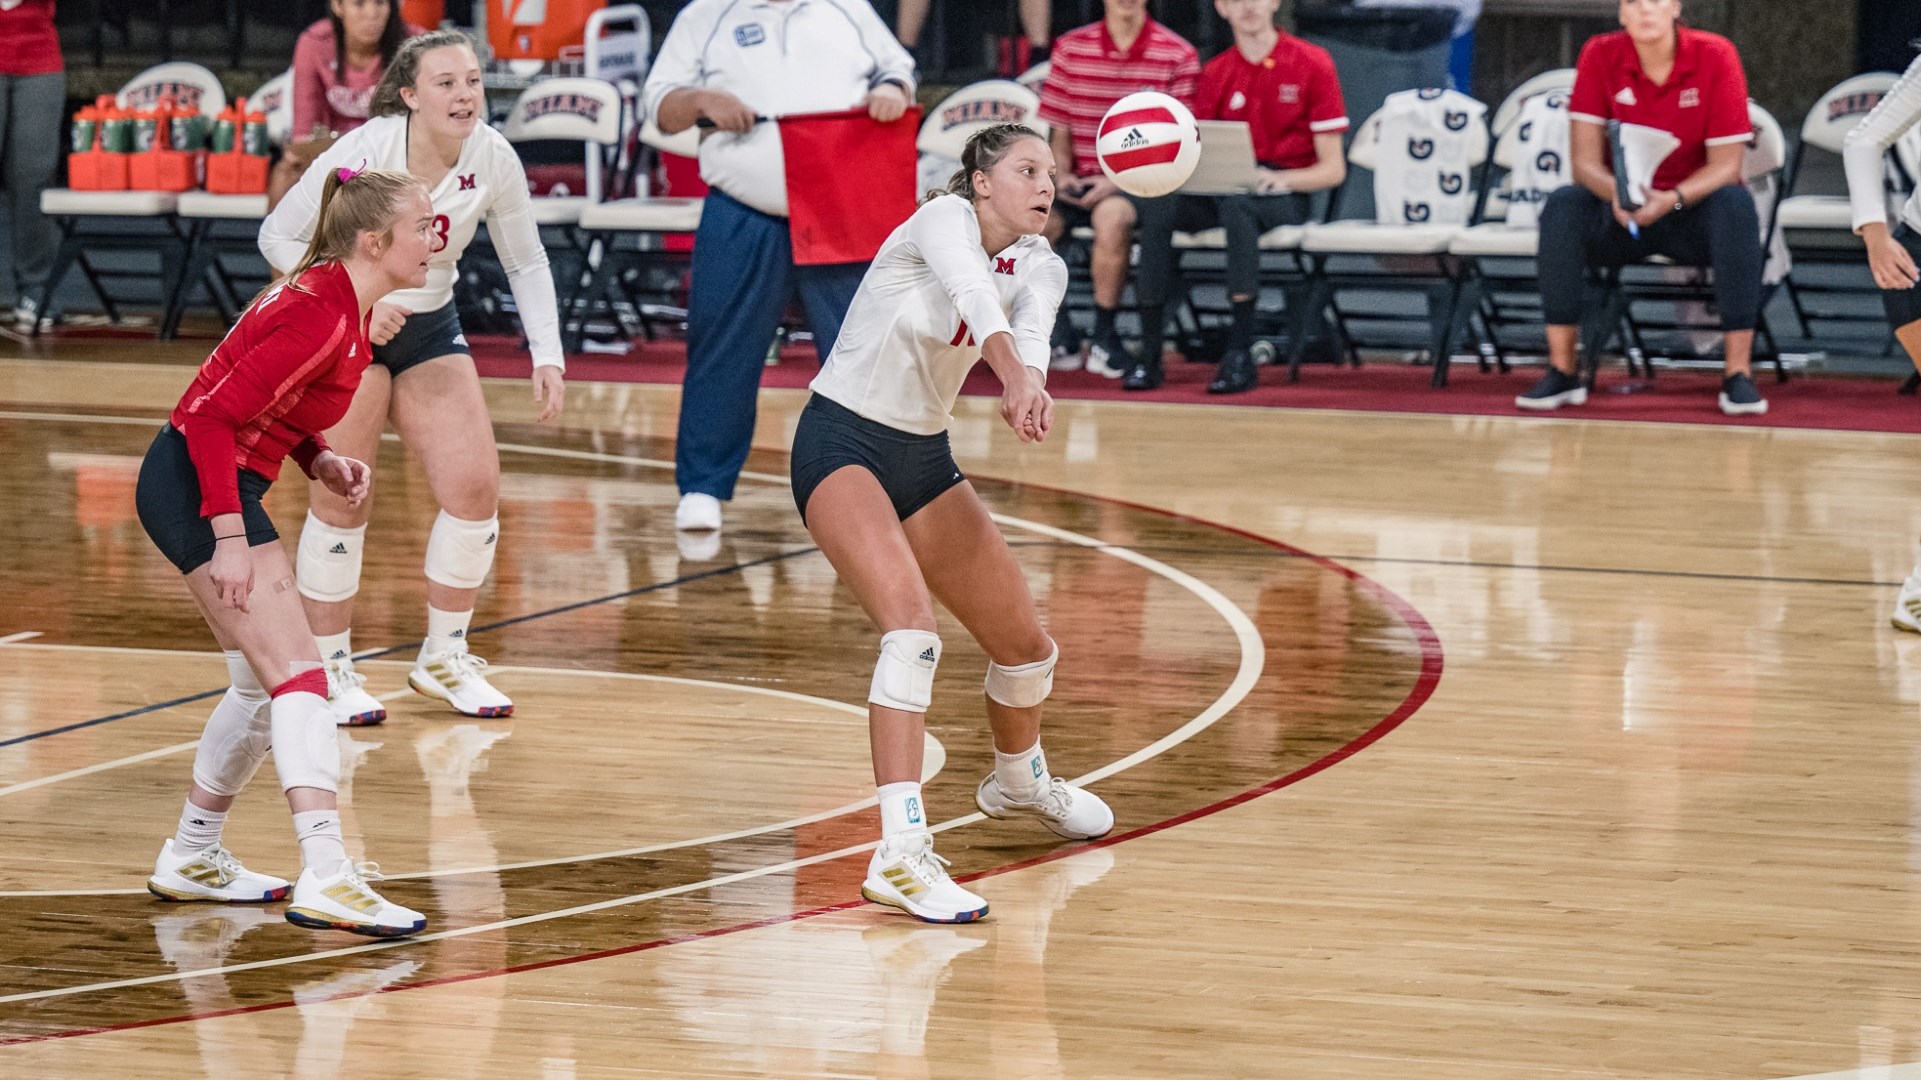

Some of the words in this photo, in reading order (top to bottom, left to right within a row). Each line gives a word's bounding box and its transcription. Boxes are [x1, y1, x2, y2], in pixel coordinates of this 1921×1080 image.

[523, 94, 605, 123] MIAMI
[943, 100, 1027, 131] MIAMI
[1121, 138, 1150, 150] adidas
[457, 173, 477, 192] M
[994, 256, 1017, 276] M
